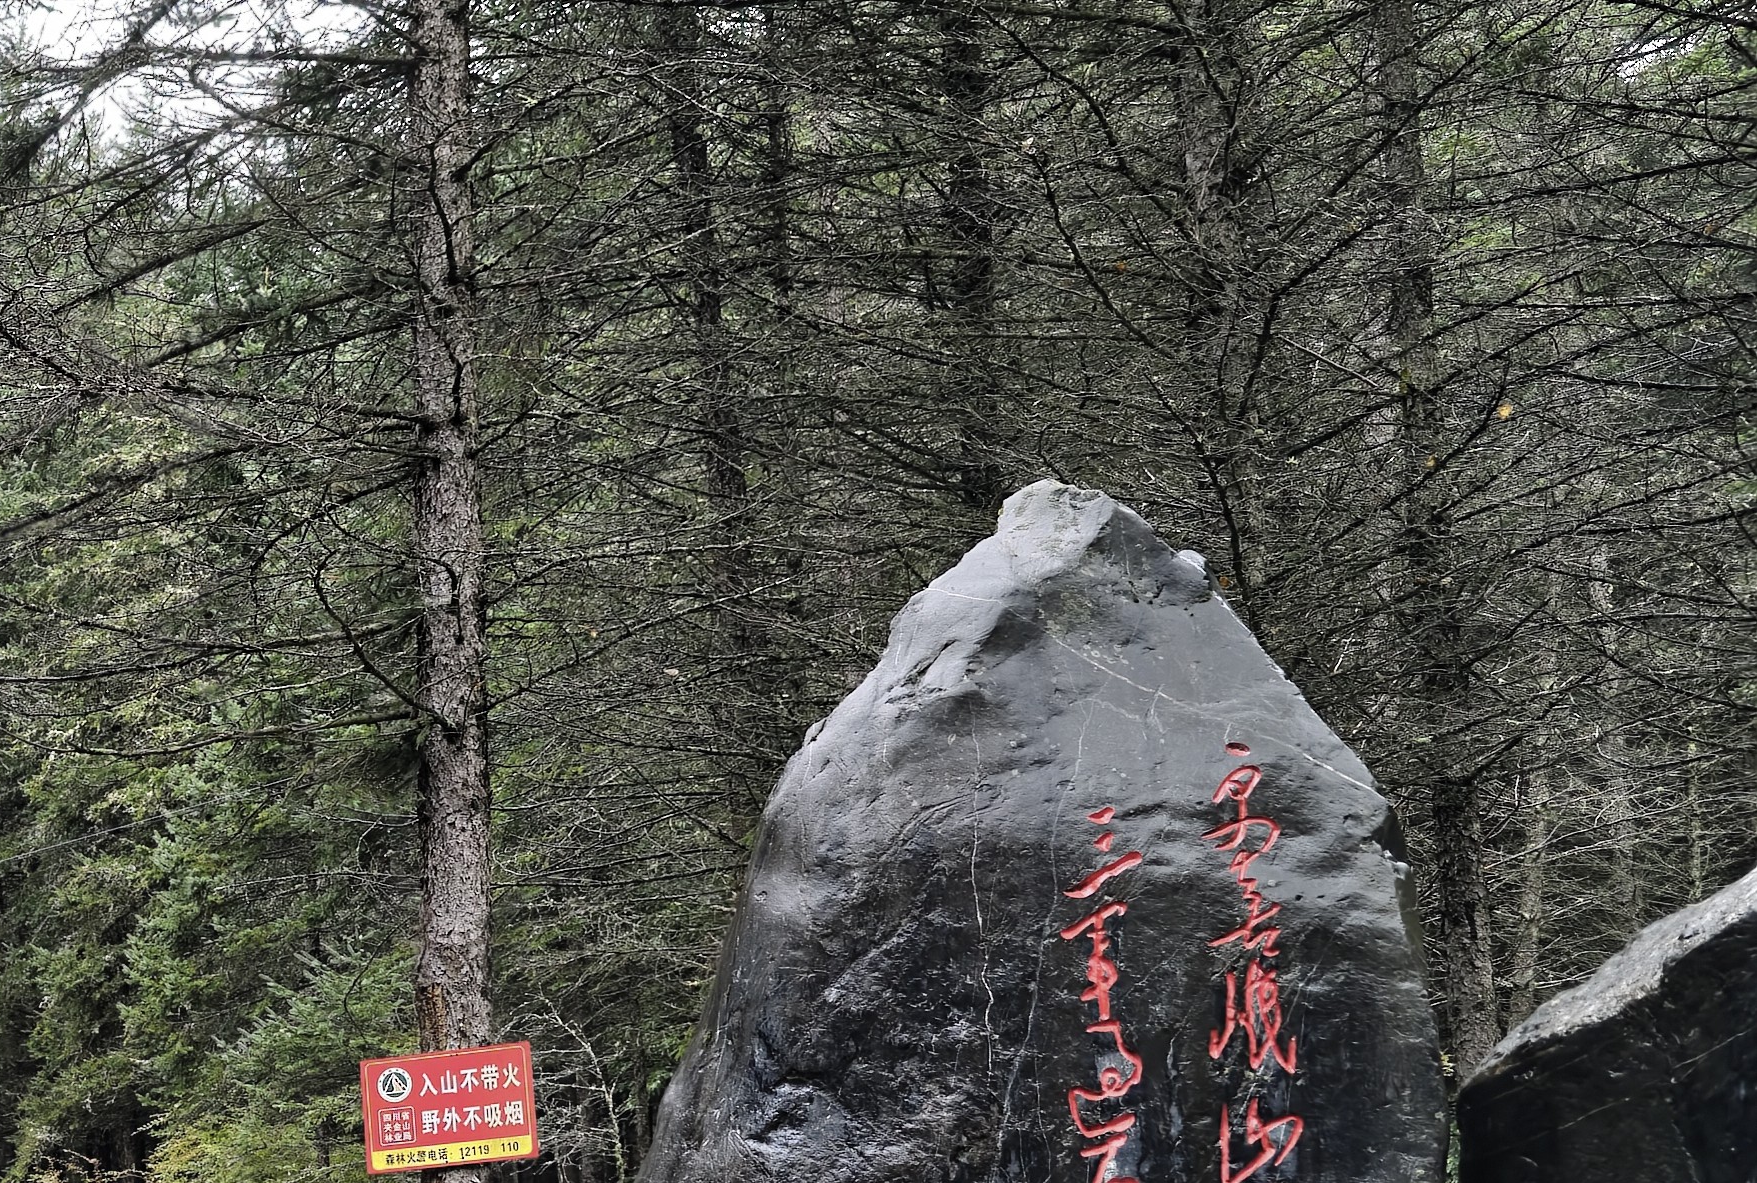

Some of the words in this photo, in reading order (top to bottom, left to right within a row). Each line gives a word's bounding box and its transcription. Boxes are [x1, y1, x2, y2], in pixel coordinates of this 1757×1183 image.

[419, 1062, 522, 1097] 入山不带火
[382, 1111, 410, 1122] 四川省
[421, 1100, 524, 1135] 野外不吸烟
[383, 1121, 411, 1132] 夹金山
[384, 1131, 412, 1142] 林业局
[459, 1144, 490, 1159] 12119
[501, 1141, 519, 1152] 110
